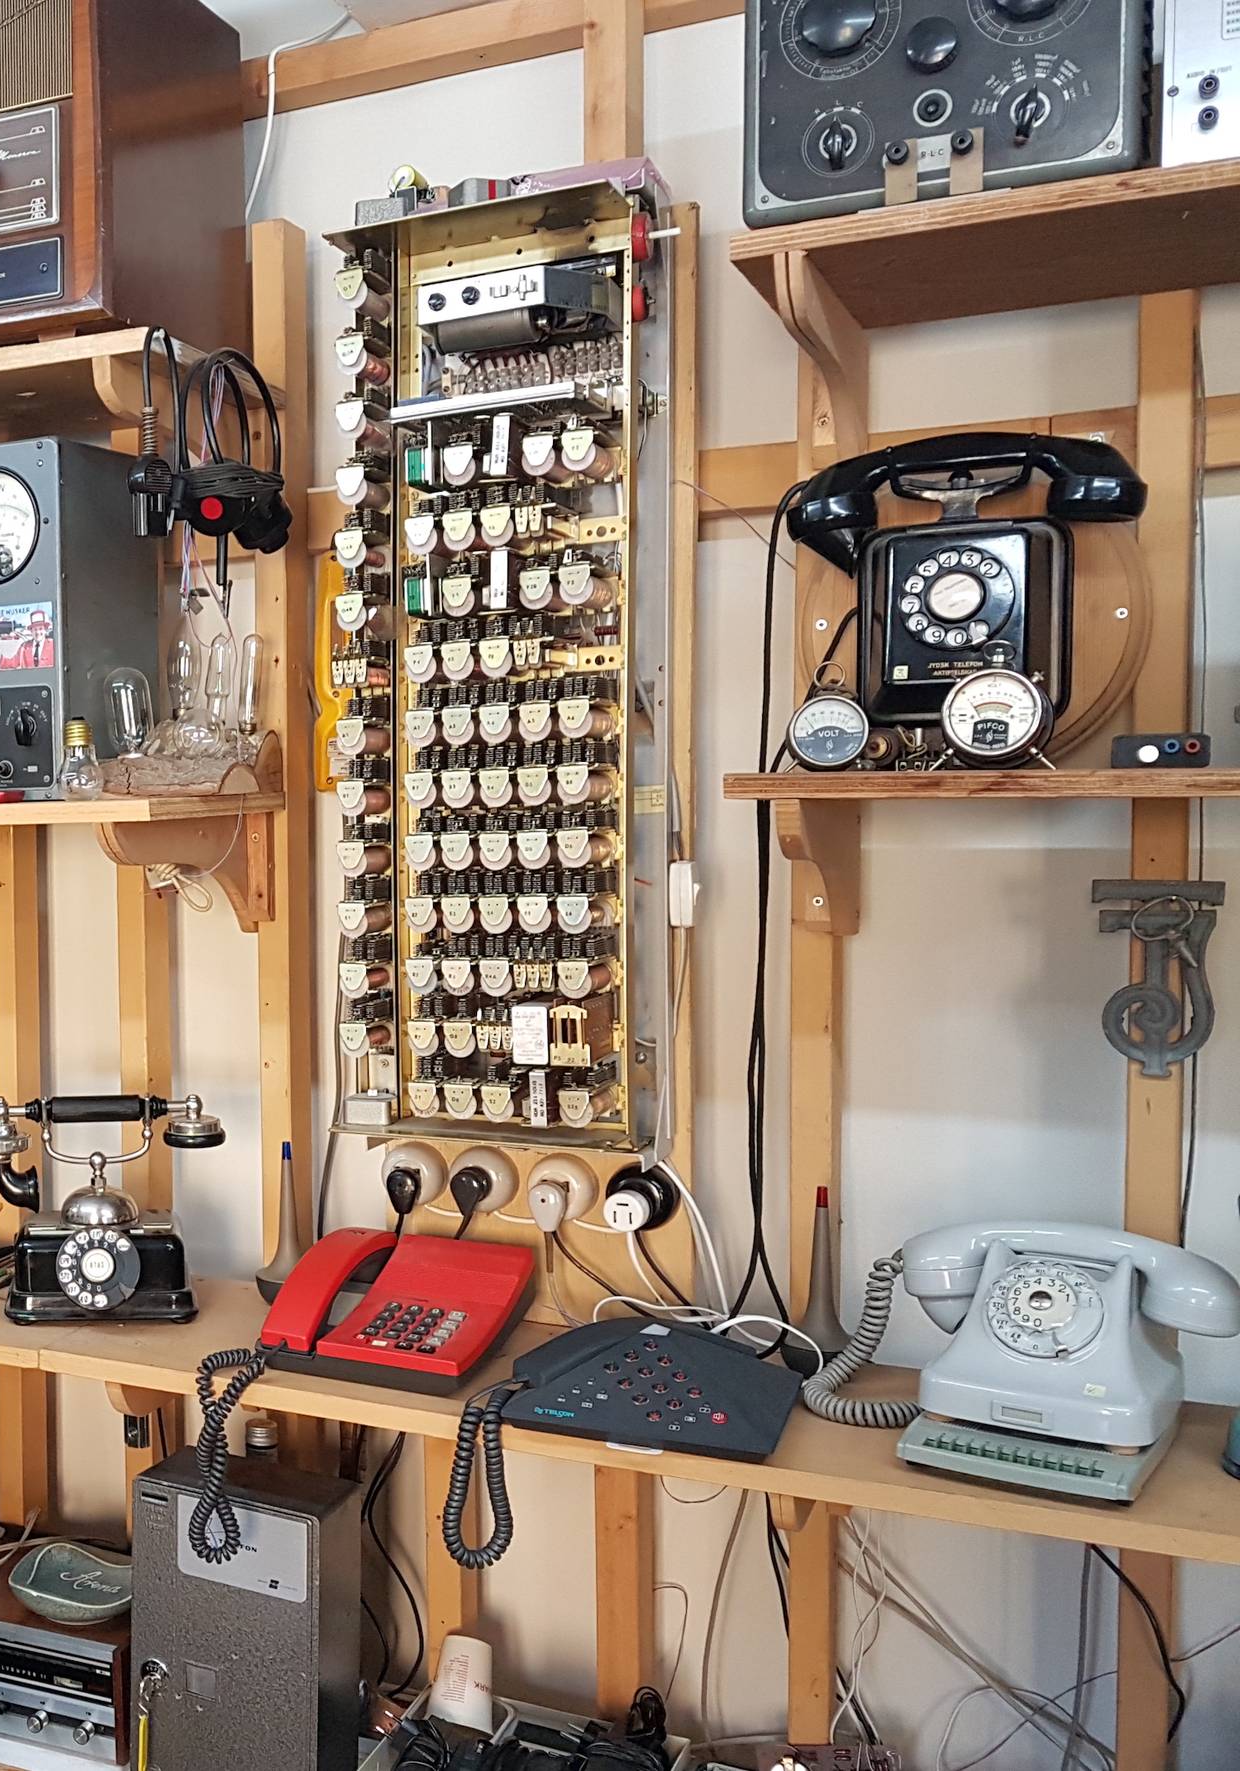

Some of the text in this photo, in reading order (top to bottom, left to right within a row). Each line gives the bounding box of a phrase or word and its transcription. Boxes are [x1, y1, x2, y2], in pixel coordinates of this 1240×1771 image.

[942, 554, 952, 568] 4
[965, 554, 974, 566] 3
[923, 565, 932, 574] 5
[984, 562, 994, 576] 2
[907, 602, 916, 613] 7
[916, 620, 924, 632] 8
[932, 630, 942, 642] 9
[976, 722, 1006, 731] PIFCO
[818, 730, 840, 738] VOLT
[1022, 1280, 1030, 1288] 5
[1034, 1278, 1042, 1286] 4
[1048, 1278, 1056, 1287] 3
[1014, 1287, 1022, 1296] 6
[1058, 1284, 1066, 1293] 2
[1011, 1296, 1018, 1306] 7
[1066, 1294, 1070, 1302] 1
[1012, 1306, 1021, 1316] 8
[1022, 1314, 1030, 1322] 9
[1034, 1318, 1042, 1328] 0
